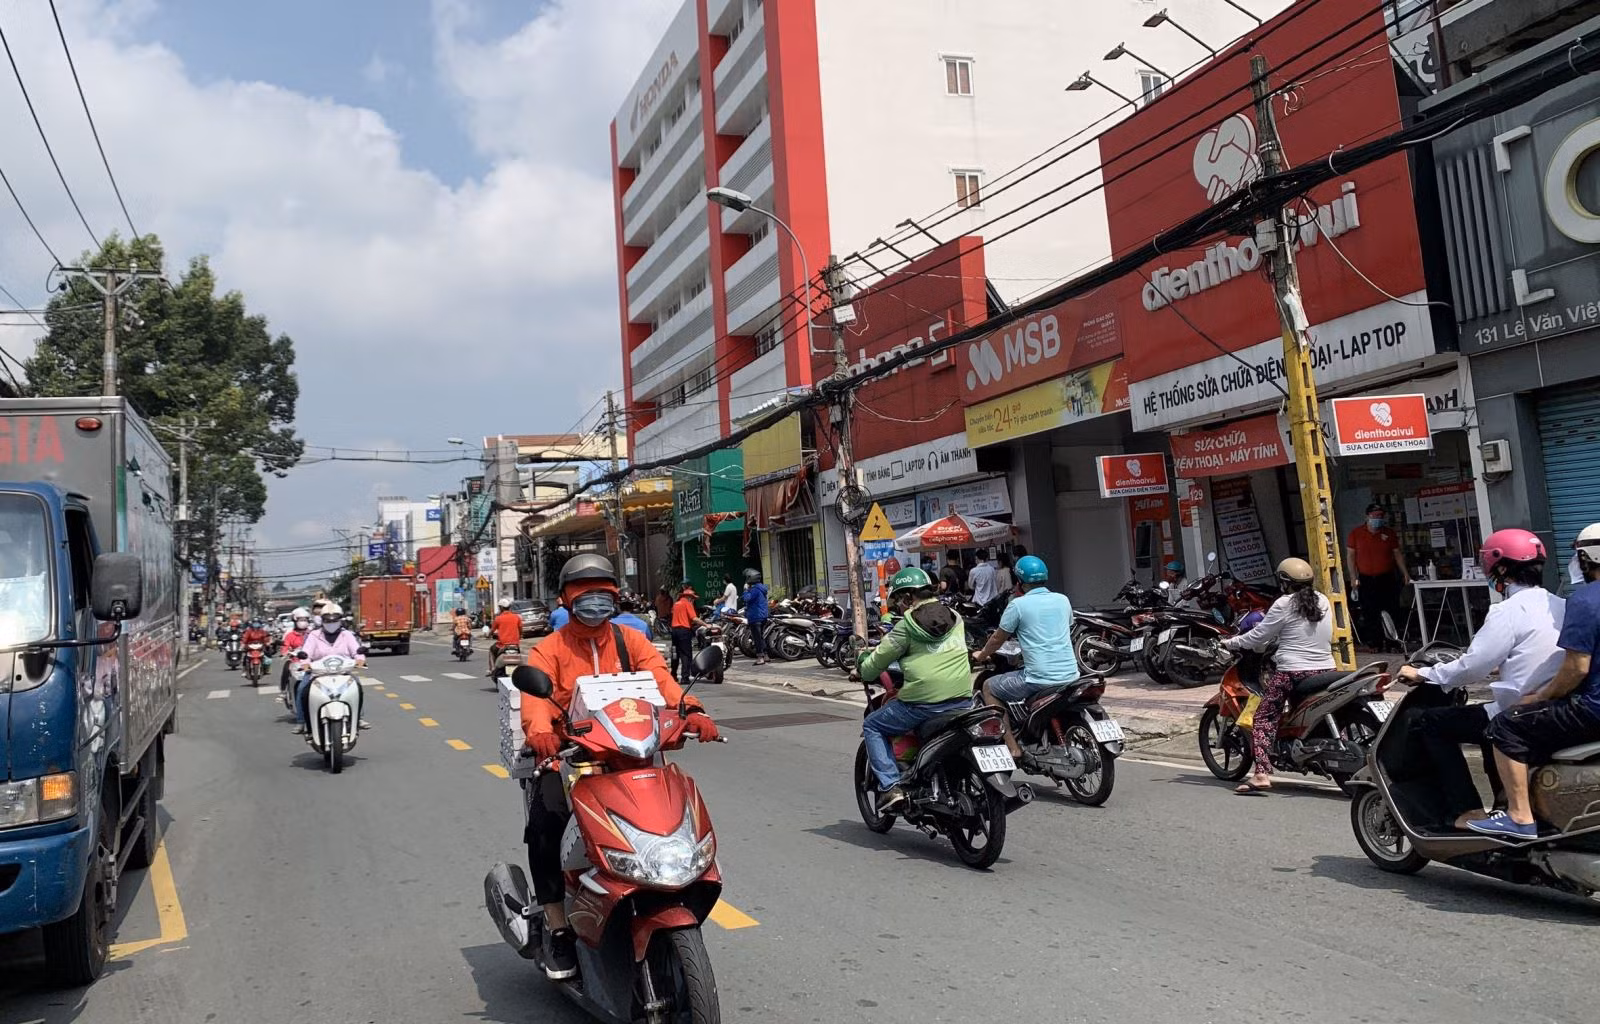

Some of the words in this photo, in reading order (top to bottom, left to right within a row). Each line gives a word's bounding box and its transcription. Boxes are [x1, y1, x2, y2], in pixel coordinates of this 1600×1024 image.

[639, 49, 679, 117] HONDA
[1474, 326, 1499, 345] 131
[1503, 320, 1526, 339] Lê
[1529, 312, 1563, 332] Văn
[1003, 314, 1061, 373] MSB
[1143, 391, 1158, 416] HỆ
[1158, 379, 1196, 411] THỐNG
[1197, 372, 1219, 400] SỬA
[1221, 365, 1253, 393] CHỮA
[1215, 430, 1247, 449] CHỮA
[1354, 426, 1414, 440] dienthoaivui
[904, 458, 925, 473] LAPTOP
[940, 450, 950, 464] ÂM
[1195, 452, 1224, 470] THOẠI
[1230, 446, 1252, 464] MÁY
[1253, 442, 1279, 460] TÍNH
[1189, 488, 1204, 501] 129
[895, 575, 913, 585] Grab
